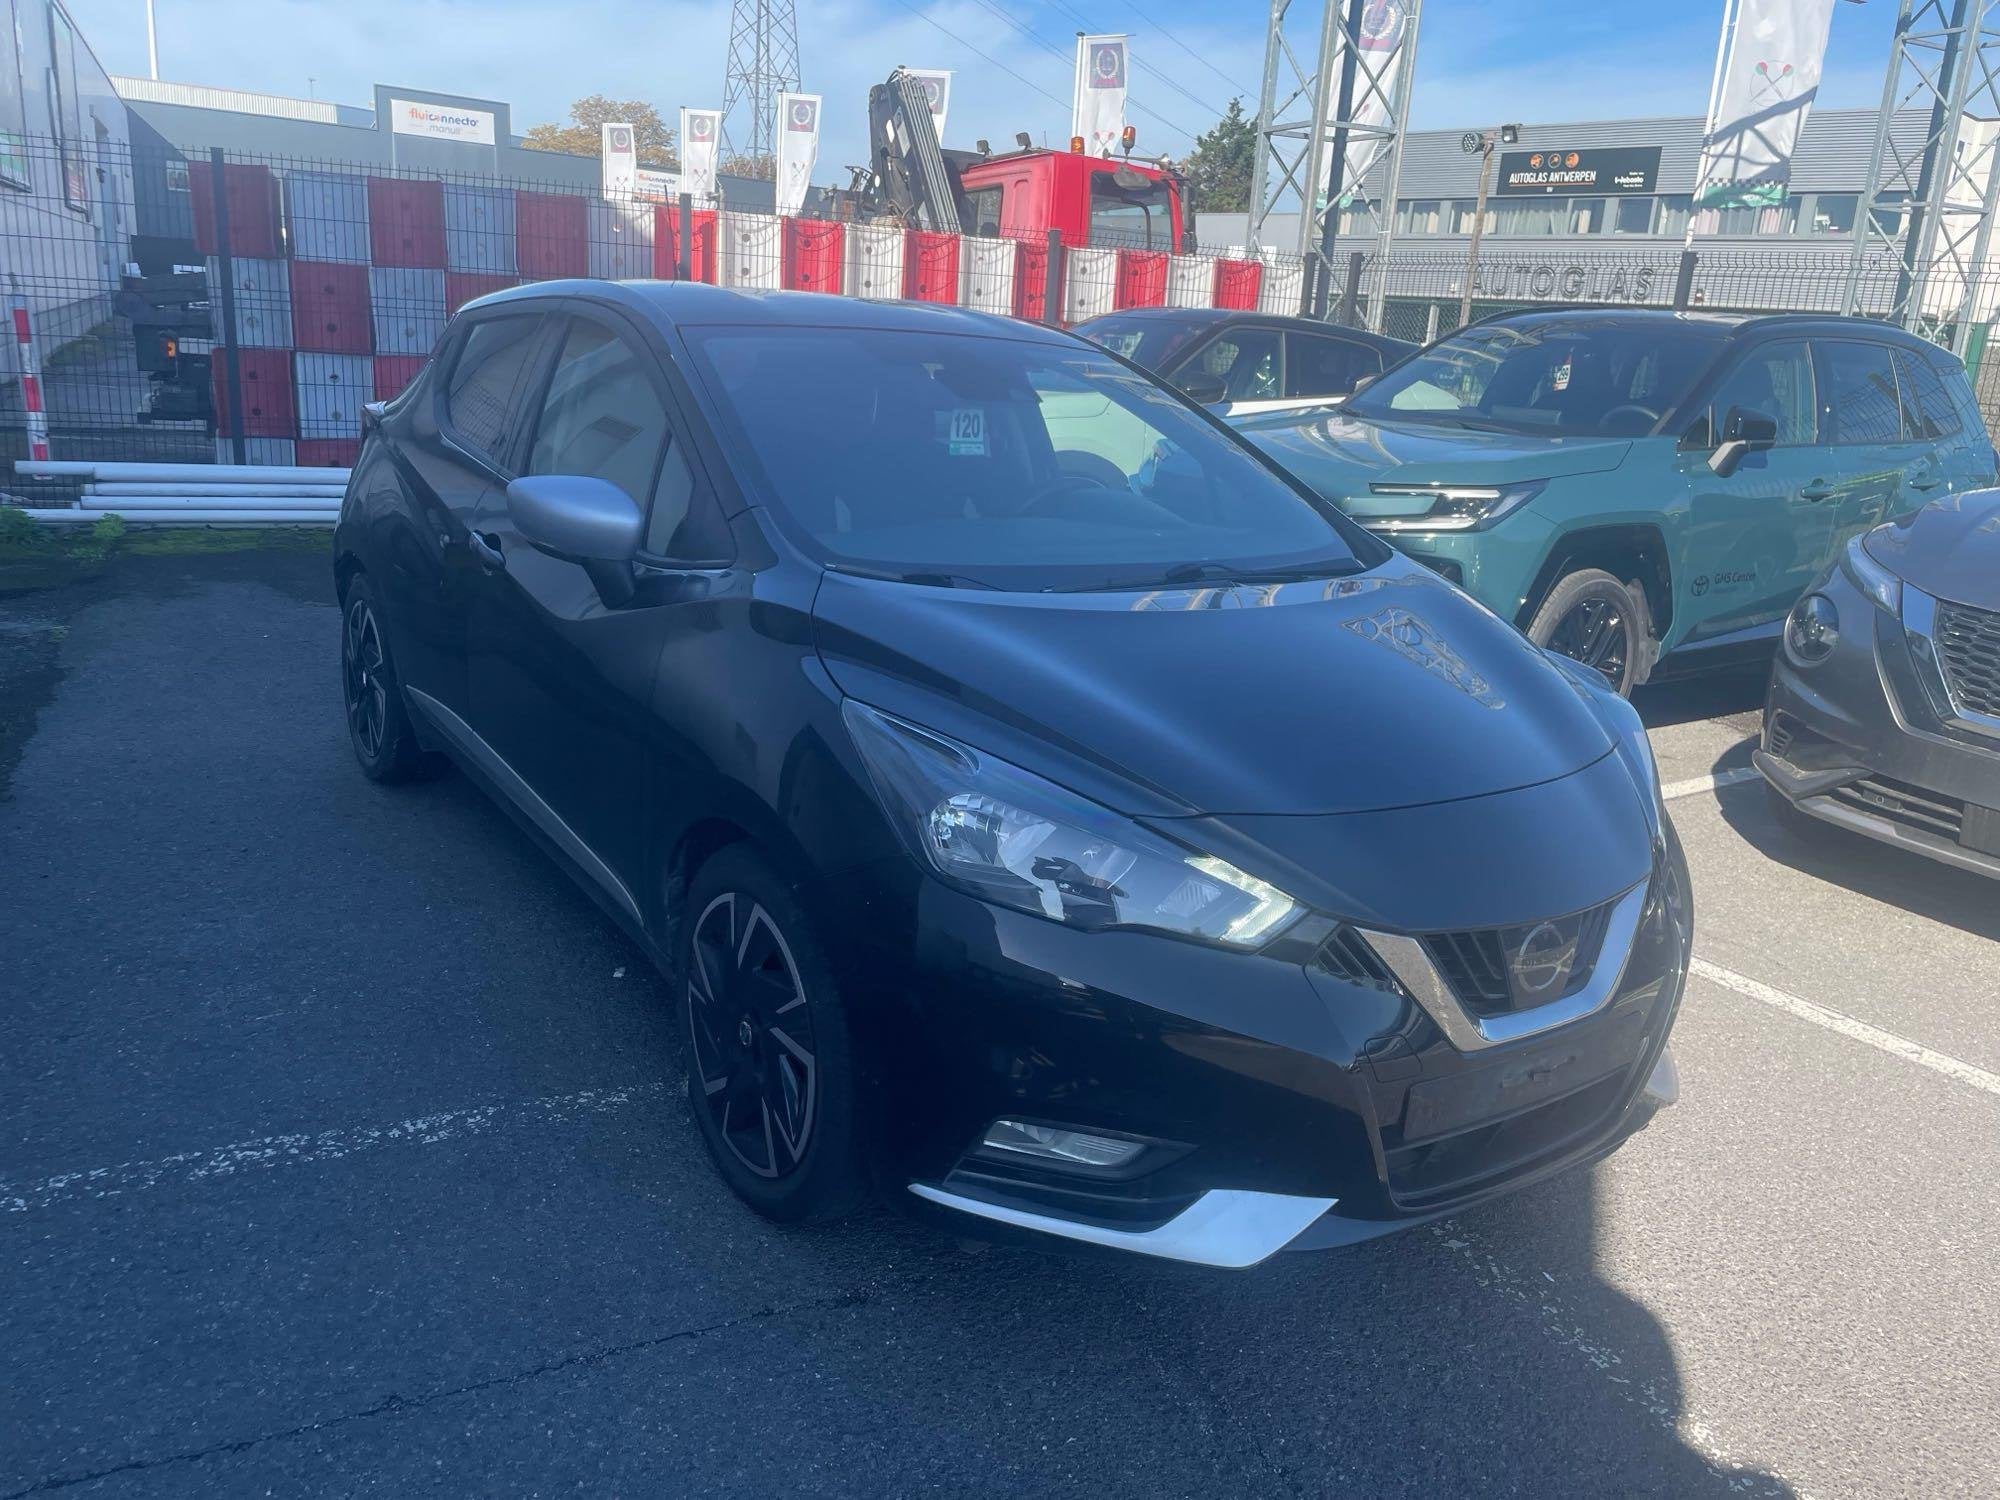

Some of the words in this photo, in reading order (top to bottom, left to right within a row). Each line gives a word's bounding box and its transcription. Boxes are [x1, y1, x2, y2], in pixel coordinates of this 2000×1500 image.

[1509, 172, 1548, 184] AUTOGLAS
[1548, 170, 1597, 183] ANTWERPEN
[1472, 264, 1655, 301] AUTOGLAS
[954, 413, 981, 438] 120
